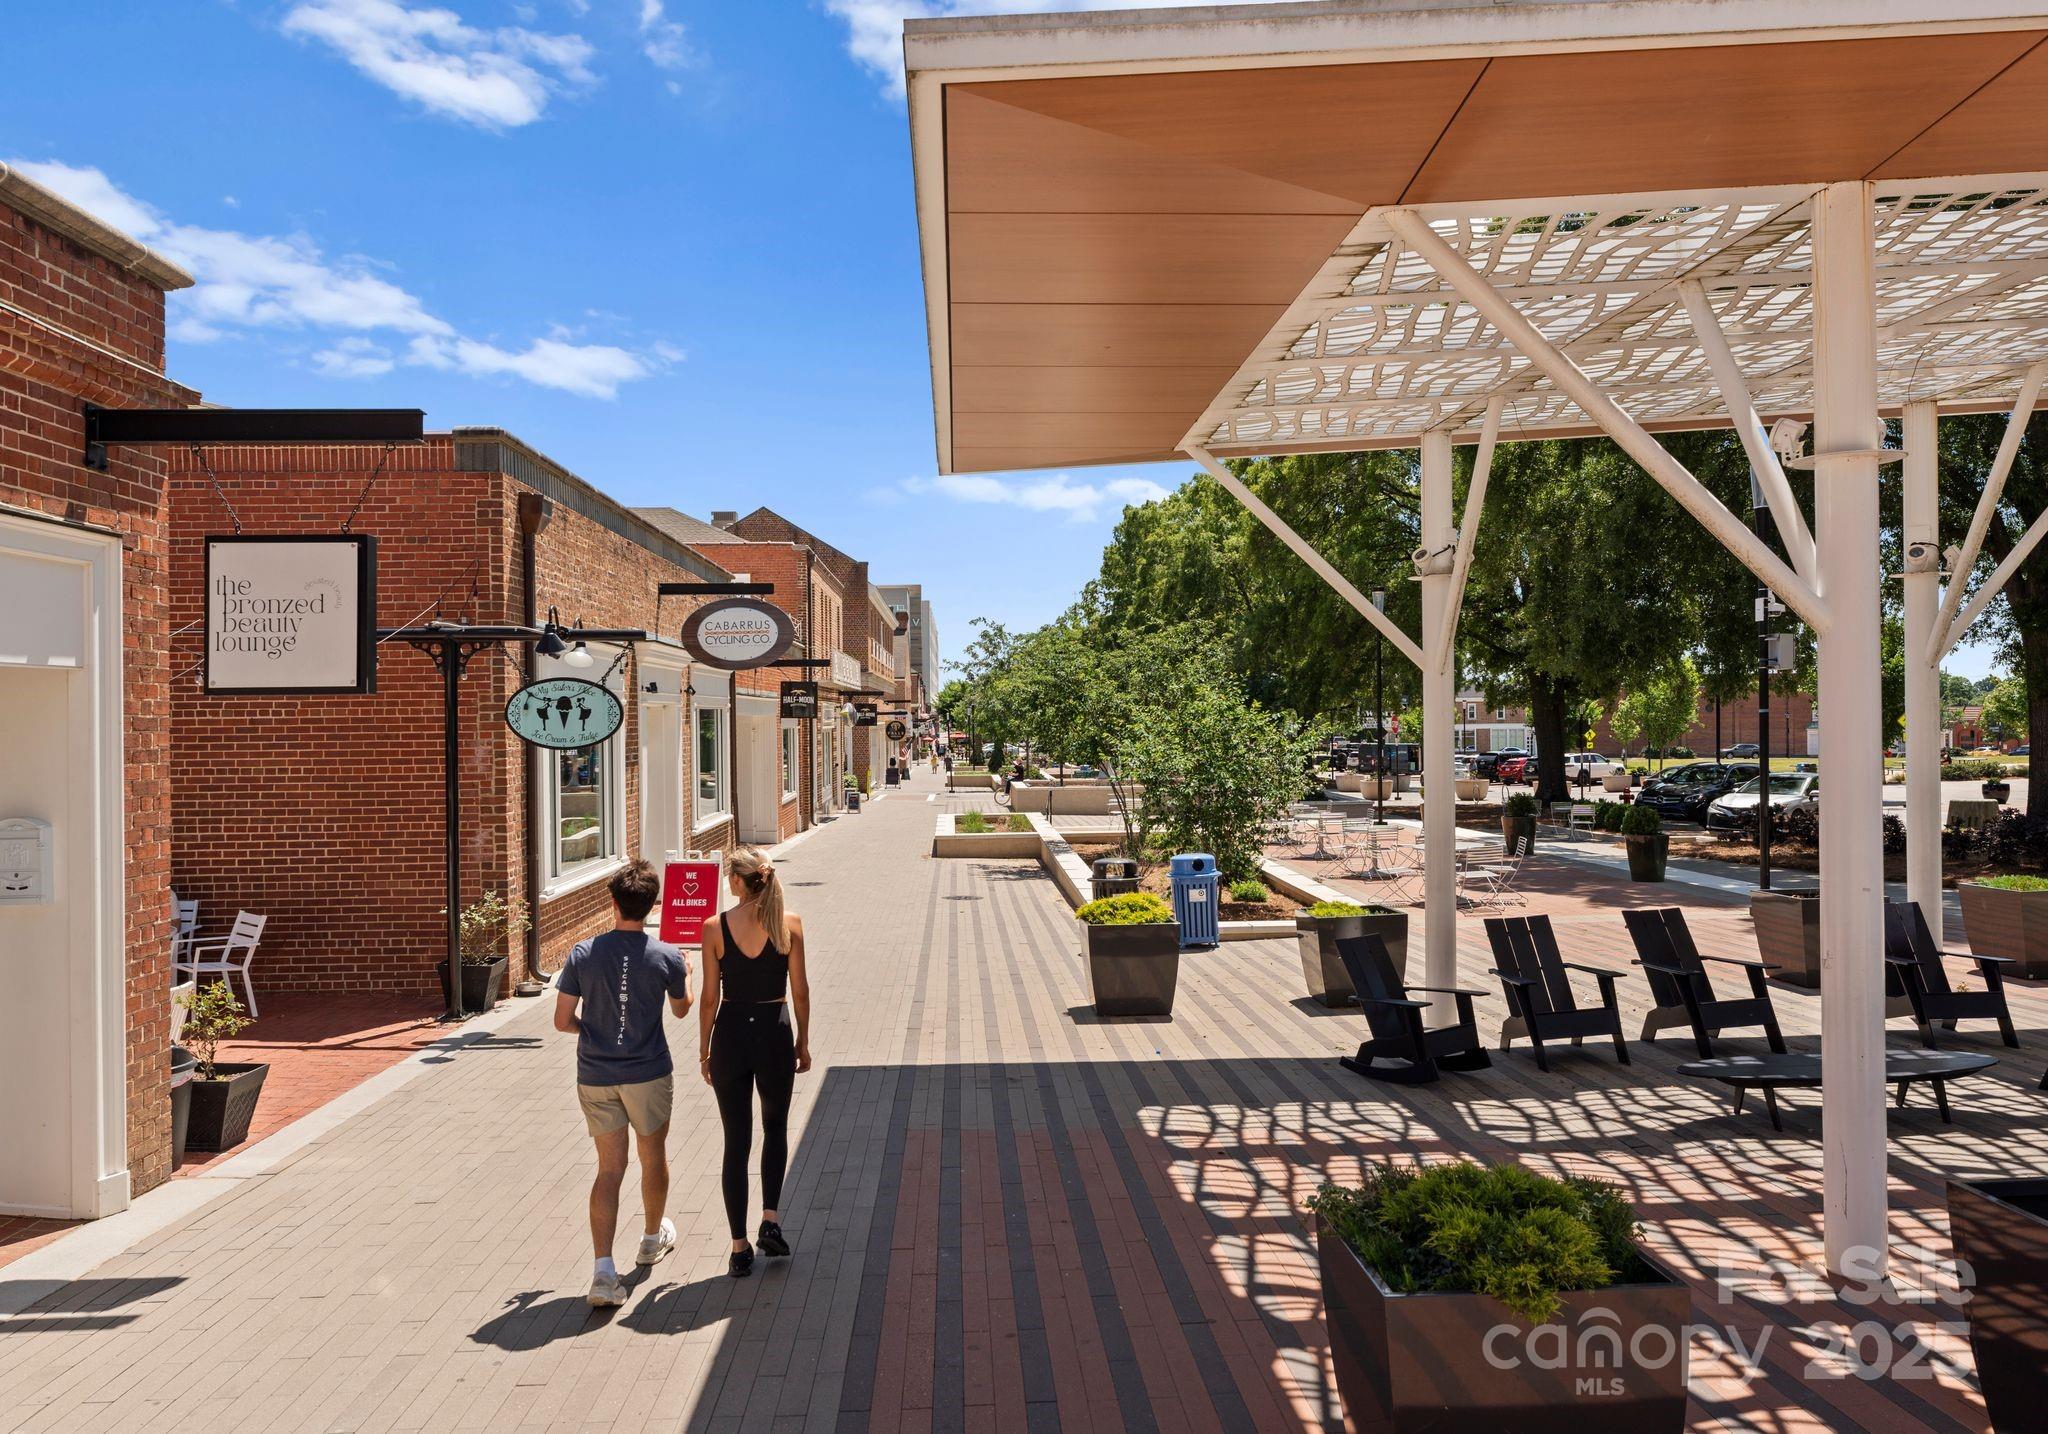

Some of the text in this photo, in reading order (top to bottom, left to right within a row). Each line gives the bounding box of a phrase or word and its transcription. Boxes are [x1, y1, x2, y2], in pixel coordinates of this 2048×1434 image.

[216, 575, 251, 595] the
[222, 594, 325, 614] bronzed
[223, 613, 302, 635] beauty
[704, 620, 771, 631] CABARRUS
[216, 631, 296, 659] lounge
[704, 634, 772, 645] CYCLING CO.
[534, 683, 596, 697] My Sister's Place
[531, 729, 542, 739] Ice
[545, 734, 567, 744] Cream
[578, 731, 599, 742] Fudge
[685, 871, 697, 880] WE
[672, 898, 707, 907] ALL BIKES
[621, 956, 629, 991] SKYCAM
[617, 1005, 626, 1045] DIGITAL
